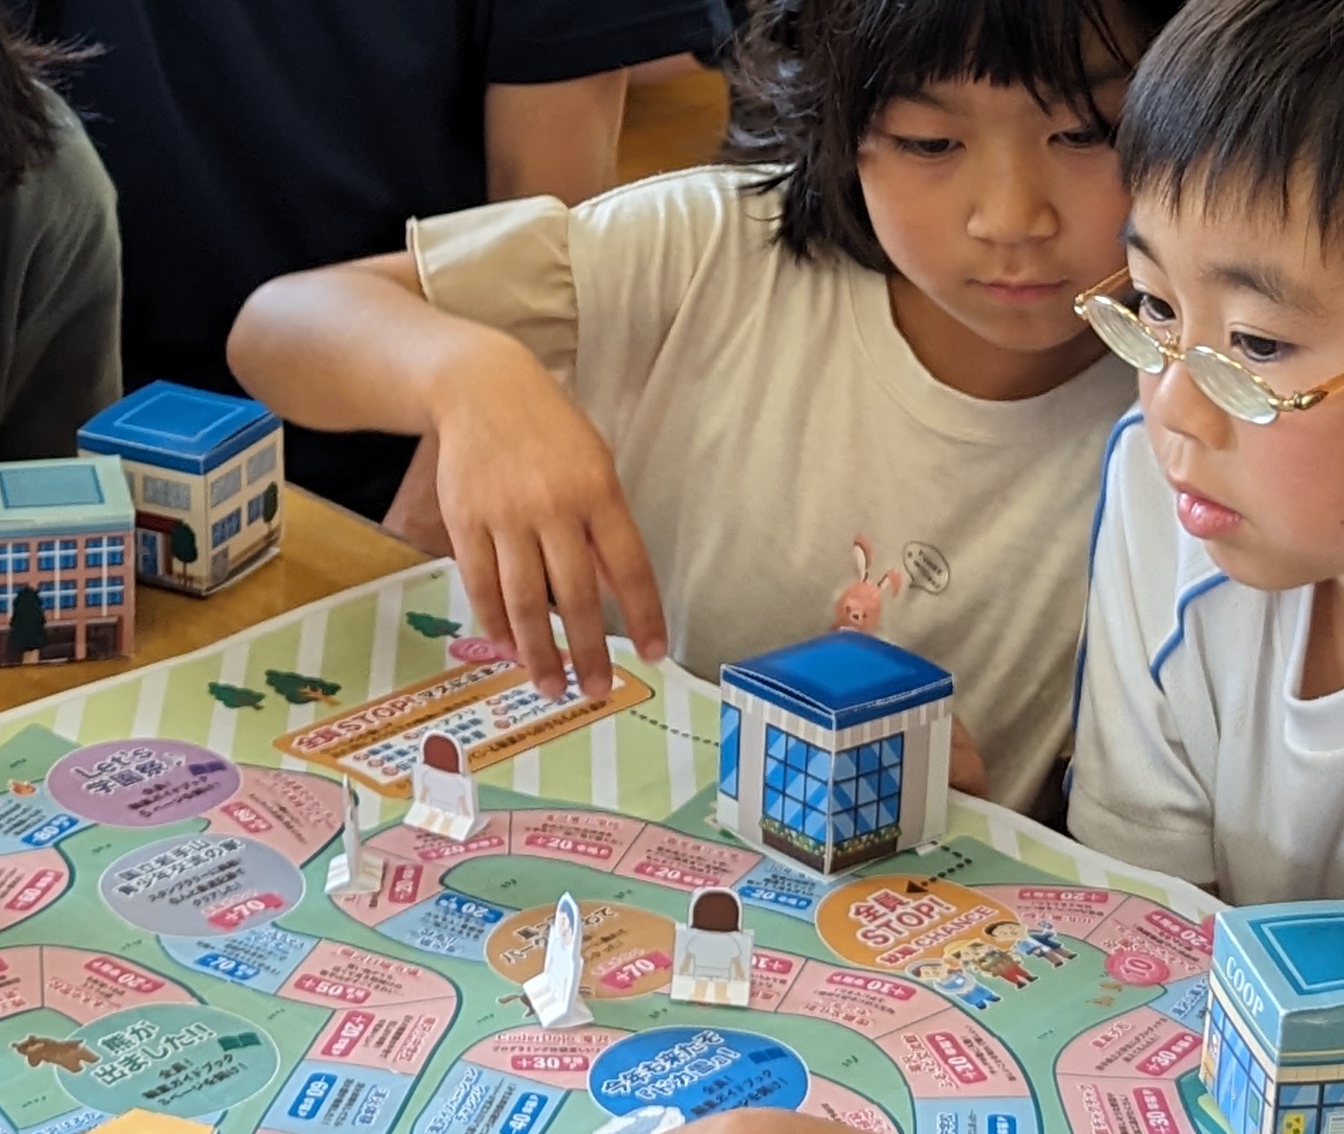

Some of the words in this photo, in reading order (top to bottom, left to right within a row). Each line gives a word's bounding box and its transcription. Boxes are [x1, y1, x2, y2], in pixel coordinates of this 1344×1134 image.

[75, 747, 153, 779] Let's
[851, 890, 911, 922] 全員
[858, 896, 954, 946] STOP!
[616, 960, 654, 982] +70
[1226, 956, 1264, 1016] COOP
[98, 1020, 159, 1055] 熊が
[517, 1056, 560, 1069] +30
[1147, 1051, 1177, 1073] +30
